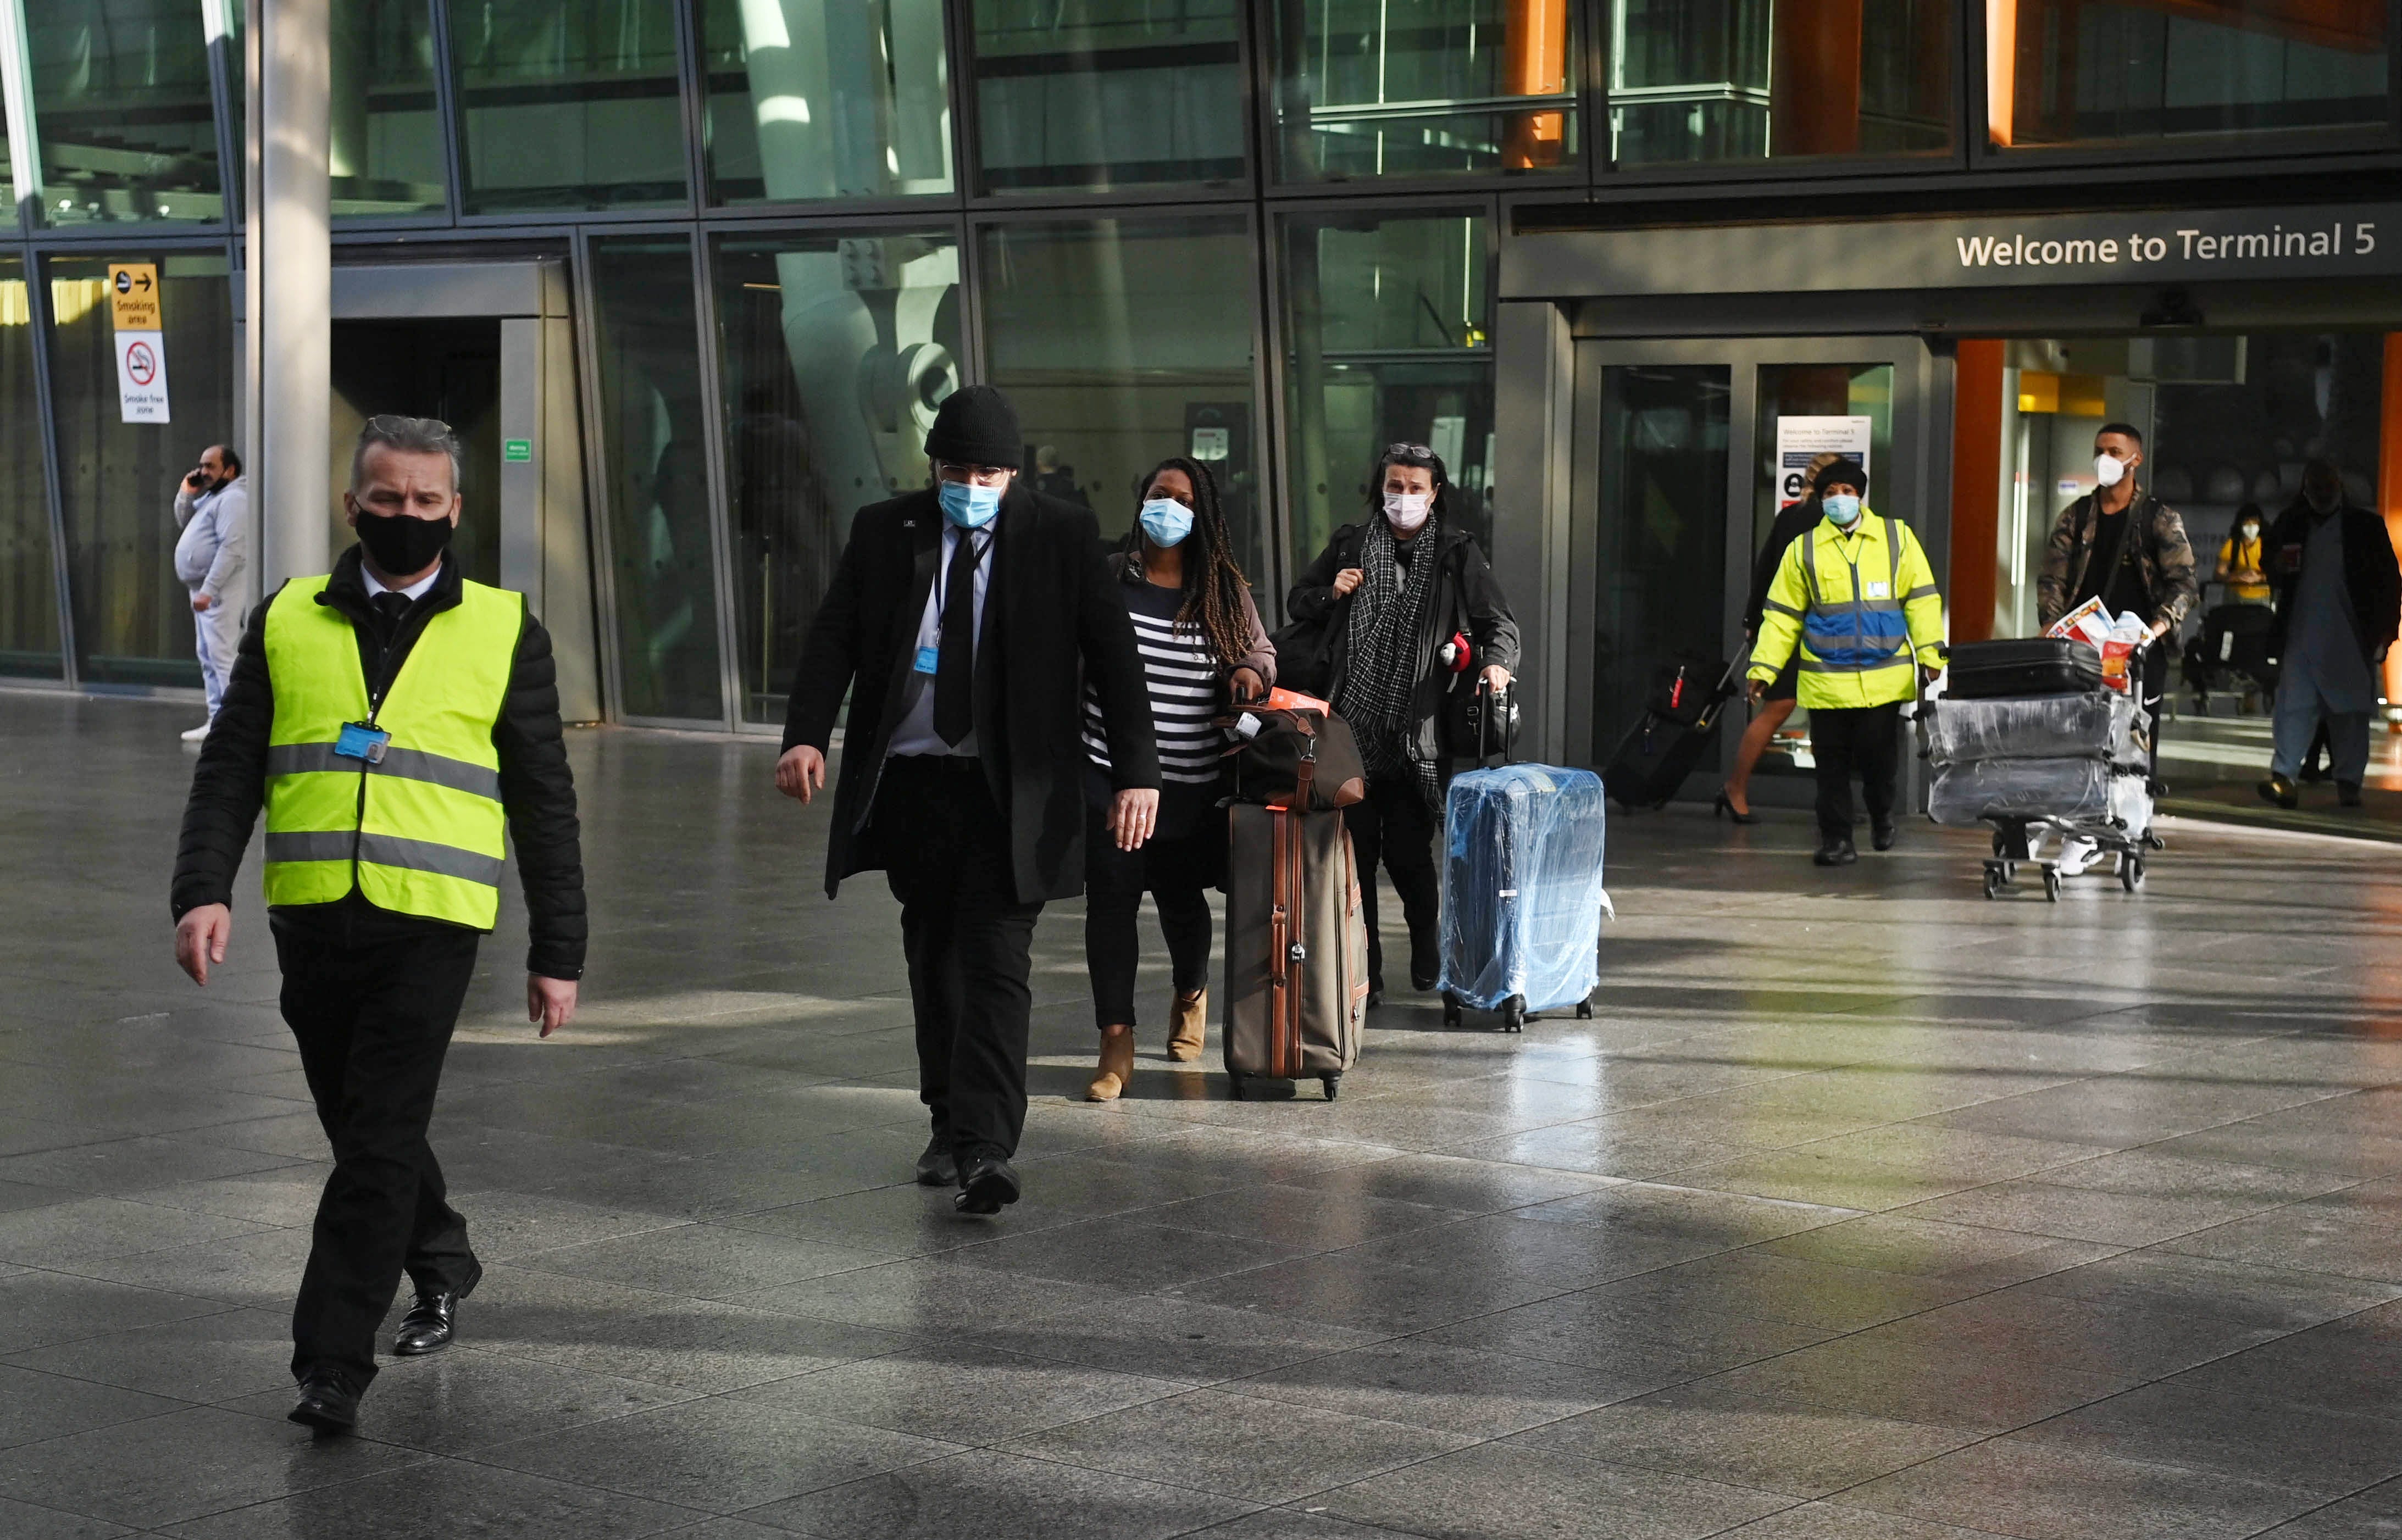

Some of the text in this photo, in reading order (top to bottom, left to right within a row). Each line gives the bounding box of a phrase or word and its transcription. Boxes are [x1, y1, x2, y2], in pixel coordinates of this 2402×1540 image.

[1956, 222, 2376, 266] Welcome to Terminal 5
[117, 299, 156, 315] Smoking
[127, 315, 147, 324] area
[124, 393, 164, 404] Smoke free
[1297, 696, 1317, 708] Rapid
